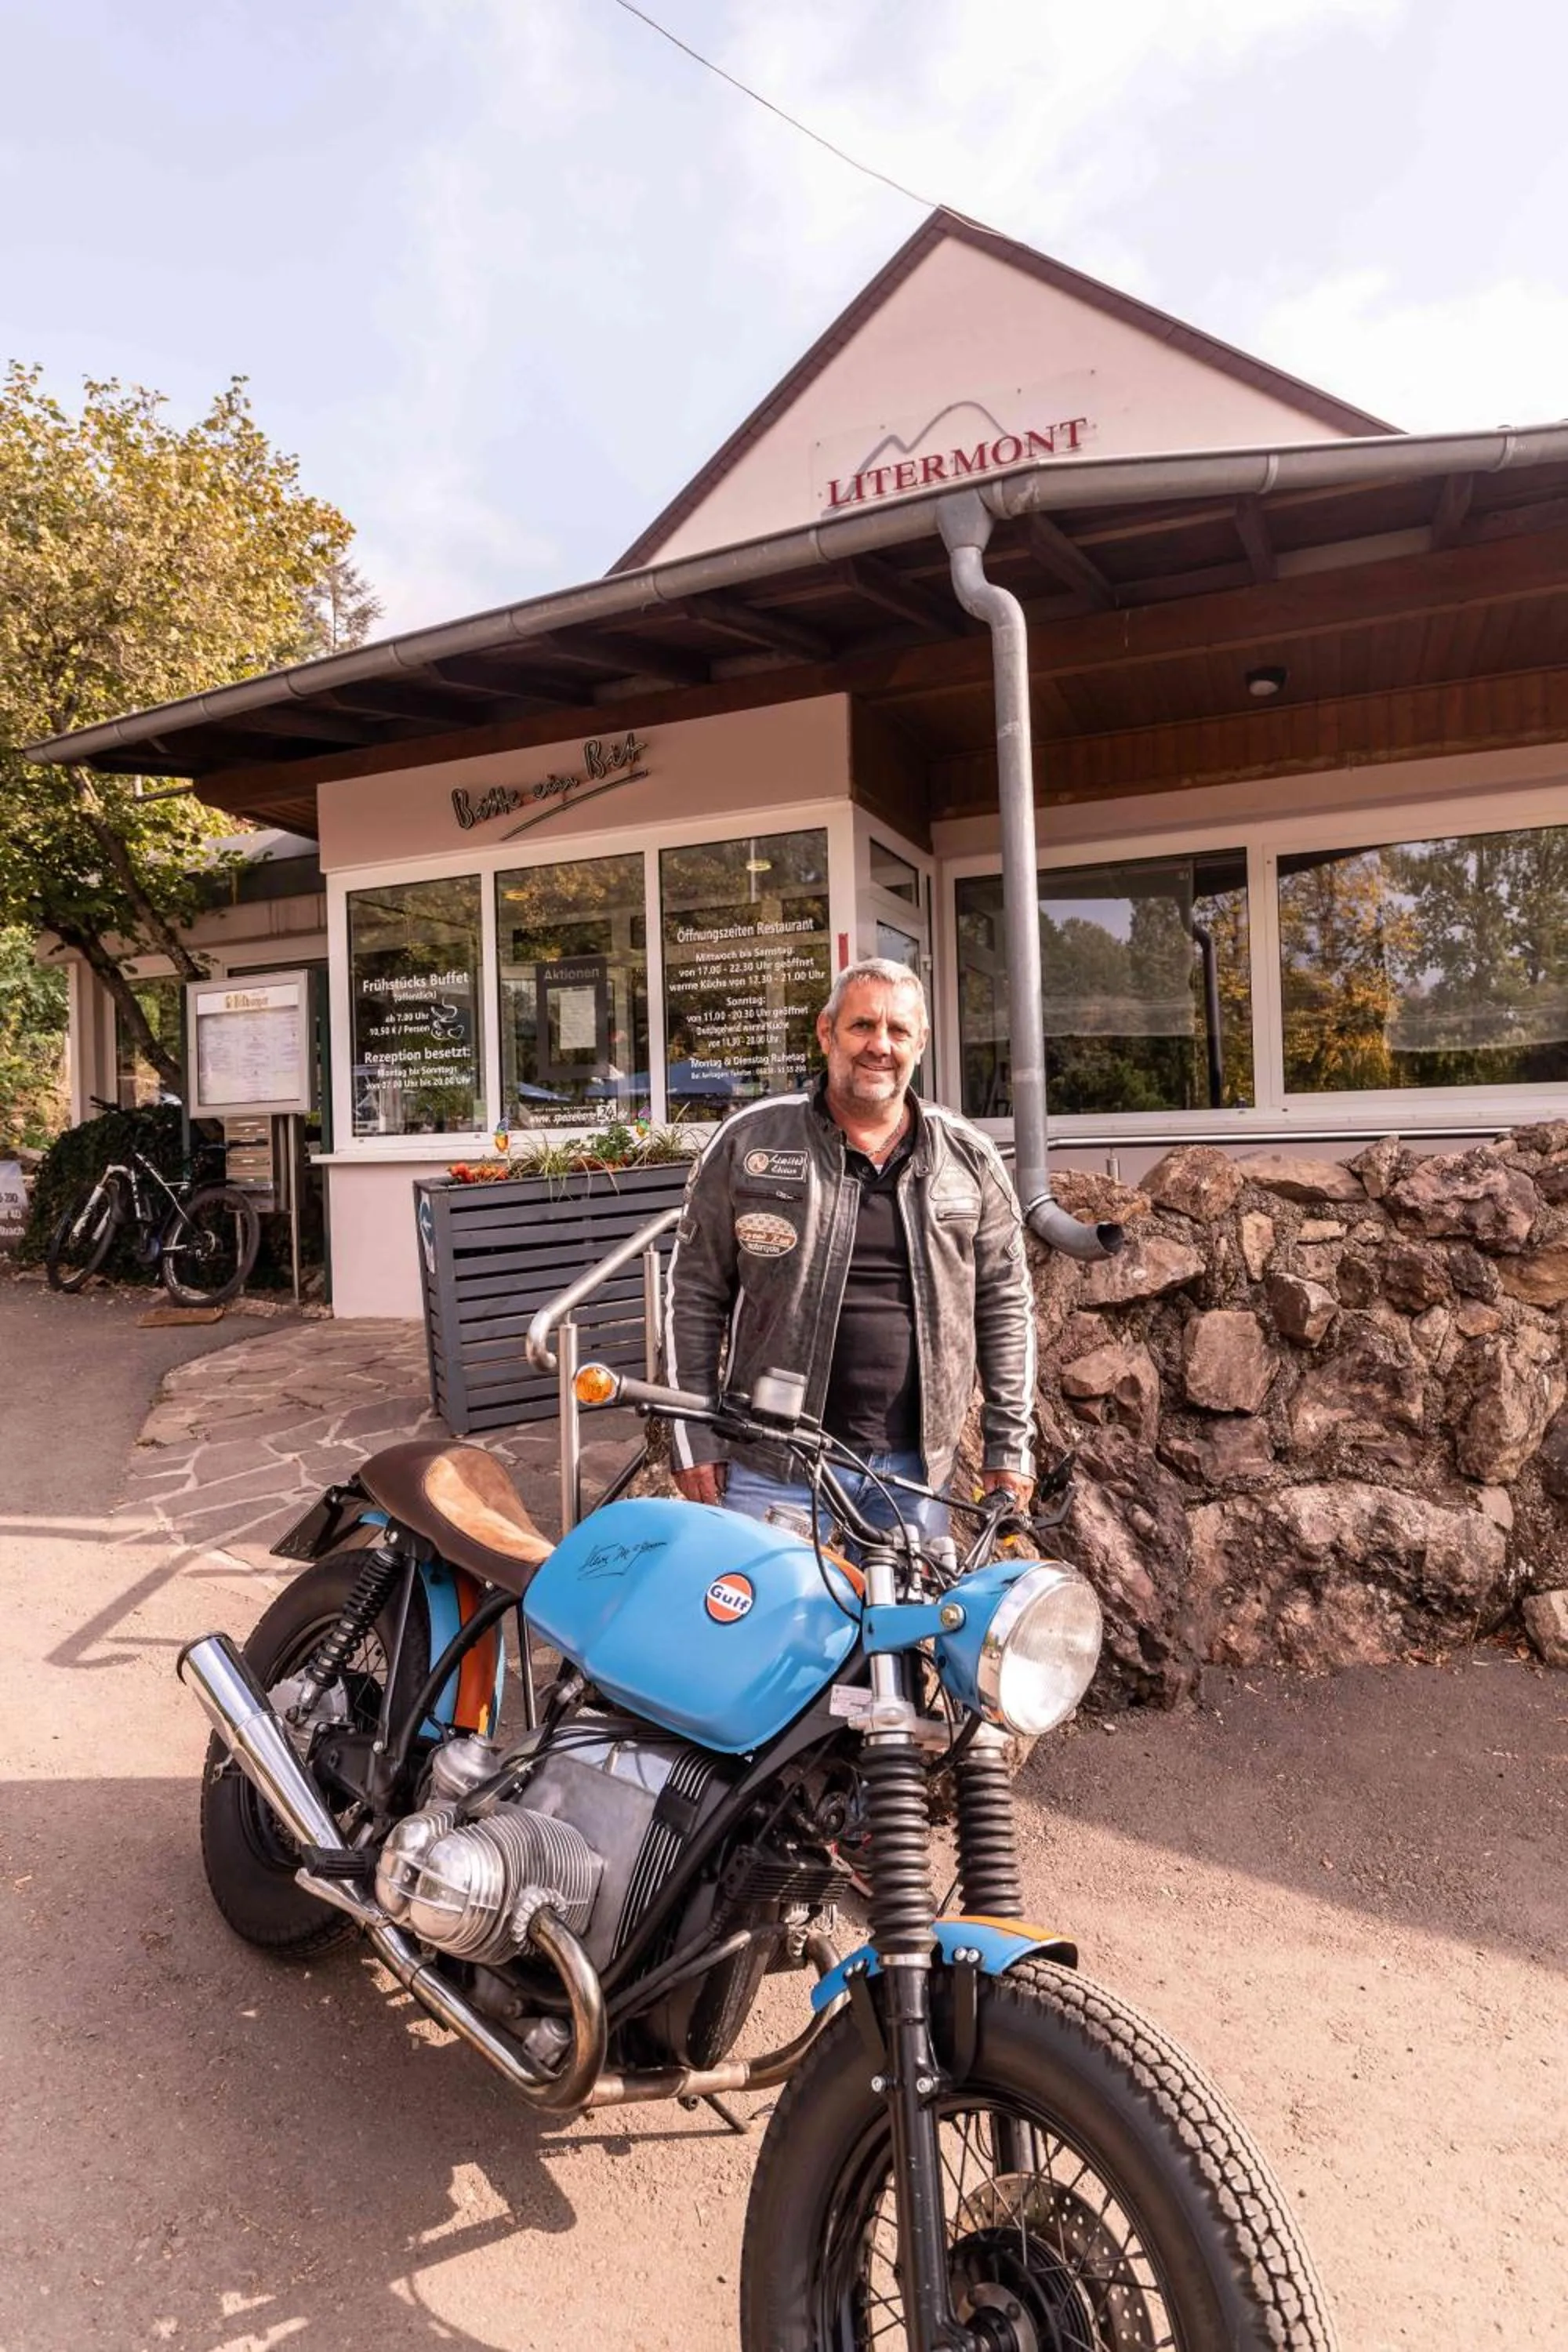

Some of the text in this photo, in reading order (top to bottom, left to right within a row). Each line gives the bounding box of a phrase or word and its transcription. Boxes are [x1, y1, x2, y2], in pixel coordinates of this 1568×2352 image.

[827, 417, 1087, 508] LITERMONT
[451, 732, 648, 830] Bitte ein Bit
[677, 917, 815, 943] Öffnungszeiten Restaurant
[695, 951, 738, 963] Mittwoch
[739, 948, 753, 958] bis
[545, 967, 600, 981] Aktionen
[679, 968, 695, 978] von
[699, 965, 722, 976] 17.00
[729, 963, 753, 973] 22.30
[756, 960, 772, 970] Uhr
[775, 957, 815, 971] geöffnet
[362, 971, 470, 993] Frühstücks Buffet
[669, 981, 699, 992] warme
[700, 978, 727, 989] Küche
[728, 978, 746, 988] von
[782, 971, 806, 982] 21.00
[808, 969, 826, 980] Uhr
[726, 996, 766, 1008] Sonntag:
[385, 1014, 396, 1023] ab
[415, 1012, 430, 1021] Uhr
[687, 1014, 702, 1023] von
[757, 1007, 771, 1018] Uhr
[772, 1006, 808, 1020] geöffnet
[404, 1024, 430, 1034] Person
[365, 1047, 471, 1065] Rezeption besetzt:
[691, 1058, 722, 1069] Montag
[733, 1054, 769, 1068] Dienstag
[771, 1053, 807, 1065] Ruhetag
[377, 1068, 407, 1078] Montag
[408, 1067, 420, 1076] bis
[709, 1584, 751, 1613] Gulf
